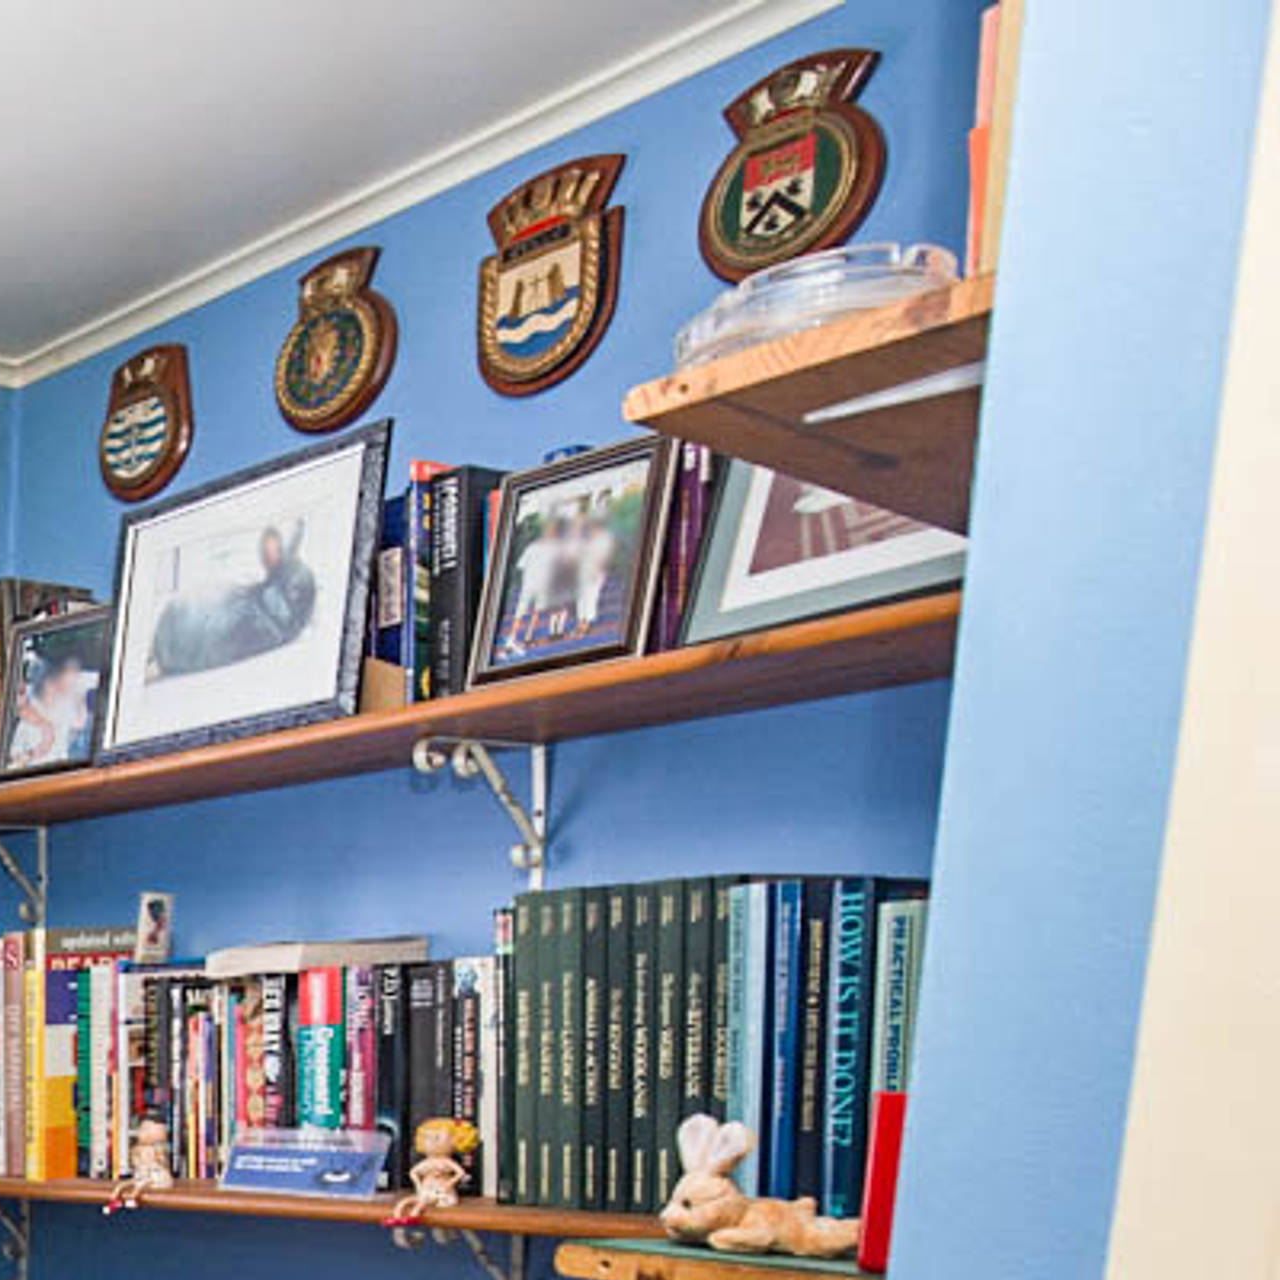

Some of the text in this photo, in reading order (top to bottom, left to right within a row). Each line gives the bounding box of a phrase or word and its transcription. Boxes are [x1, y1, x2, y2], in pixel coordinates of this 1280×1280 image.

[830, 891, 865, 1147] HOW IS IT DONE?
[886, 915, 907, 1092] PRACTICAL PROBLE
